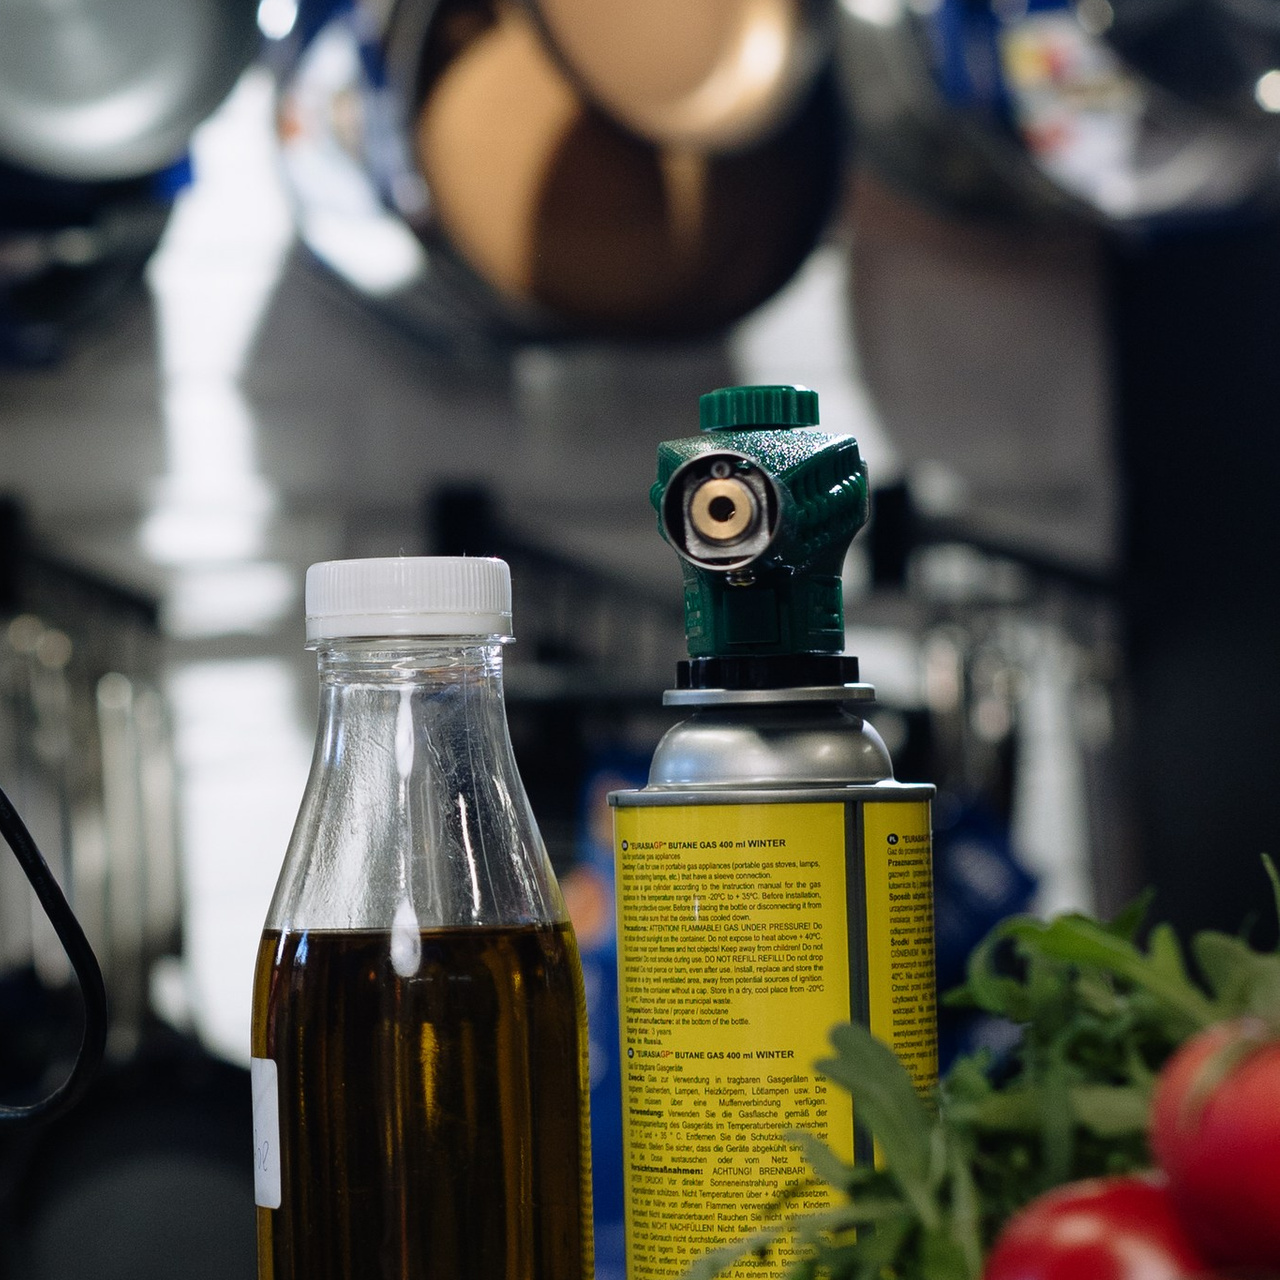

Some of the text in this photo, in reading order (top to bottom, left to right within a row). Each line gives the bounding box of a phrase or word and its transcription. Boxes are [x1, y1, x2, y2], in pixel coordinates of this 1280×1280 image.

[668, 841, 698, 849] BUTANE
[700, 841, 717, 849] GAS
[748, 839, 786, 848] WINTER
[698, 862, 732, 871] appliances
[732, 861, 760, 871] (portable
[762, 862, 774, 870] gas
[800, 860, 820, 869] lamps,
[736, 872, 772, 880] connection.
[673, 883, 699, 892] according
[701, 883, 708, 891] to
[722, 882, 754, 890] instruction
[758, 881, 782, 889] manual
[785, 881, 793, 889] for
[809, 882, 821, 890] gas
[727, 893, 734, 901] to
[762, 892, 784, 900] Before
[673, 904, 692, 912] Before
[730, 903, 748, 911] bottle
[757, 903, 801, 911] disconnecting
[807, 901, 822, 909] from
[710, 914, 730, 922] cooled
[681, 922, 822, 932] FLAMMABLE! GAS UNDER PRESSURE! Do
[708, 934, 715, 942] Do
[729, 935, 752, 943] expose
[754, 934, 760, 942] to
[778, 933, 797, 941] above
[721, 945, 738, 953] Keep
[757, 944, 772, 952] from
[802, 943, 812, 951] Do
[705, 955, 715, 963] DO
[716, 955, 731, 963] NOT
[732, 955, 756, 963] REFILL
[786, 954, 796, 962] Do
[809, 954, 823, 962] drop
[704, 965, 718, 973] after
[756, 965, 780, 974] replace
[720, 976, 734, 984] from
[736, 975, 762, 984] potential
[791, 975, 798, 983] of
[710, 986, 726, 994] Store
[728, 986, 734, 994] in
[755, 986, 768, 994] cool
[770, 986, 788, 994] place
[790, 985, 804, 993] from
[685, 997, 711, 1006] municipal
[700, 1007, 728, 1015] isobutane
[712, 1017, 720, 1025] of
[675, 1051, 704, 1059] BUTANE
[743, 1051, 753, 1059] ml
[756, 1050, 794, 1059] WINTER
[673, 1075, 808, 1084] Verwendung in tragbaren Gasgeräten
[815, 1085, 826, 1094] Die
[694, 1098, 781, 1107] eine Muffenverbindung
[705, 1108, 827, 1118] Sie die Gasflasche der
[716, 1120, 828, 1130] im Temperaturbereich zwischen
[720, 1132, 746, 1141] Sie die
[696, 1144, 787, 1153] dass die Geräte abgekühlt
[718, 1156, 733, 1164] oder
[772, 1156, 788, 1164] Netz
[712, 1166, 805, 1176] ACHTUNG! BRENNBAR!
[710, 1178, 778, 1187] Sonneneinstrahlung
[682, 1189, 762, 1199] Nicht Temperaturen über
[706, 1201, 736, 1209] Flammen
[718, 1213, 762, 1221] Rauchen Sie
[718, 1224, 735, 1233] Nicht
